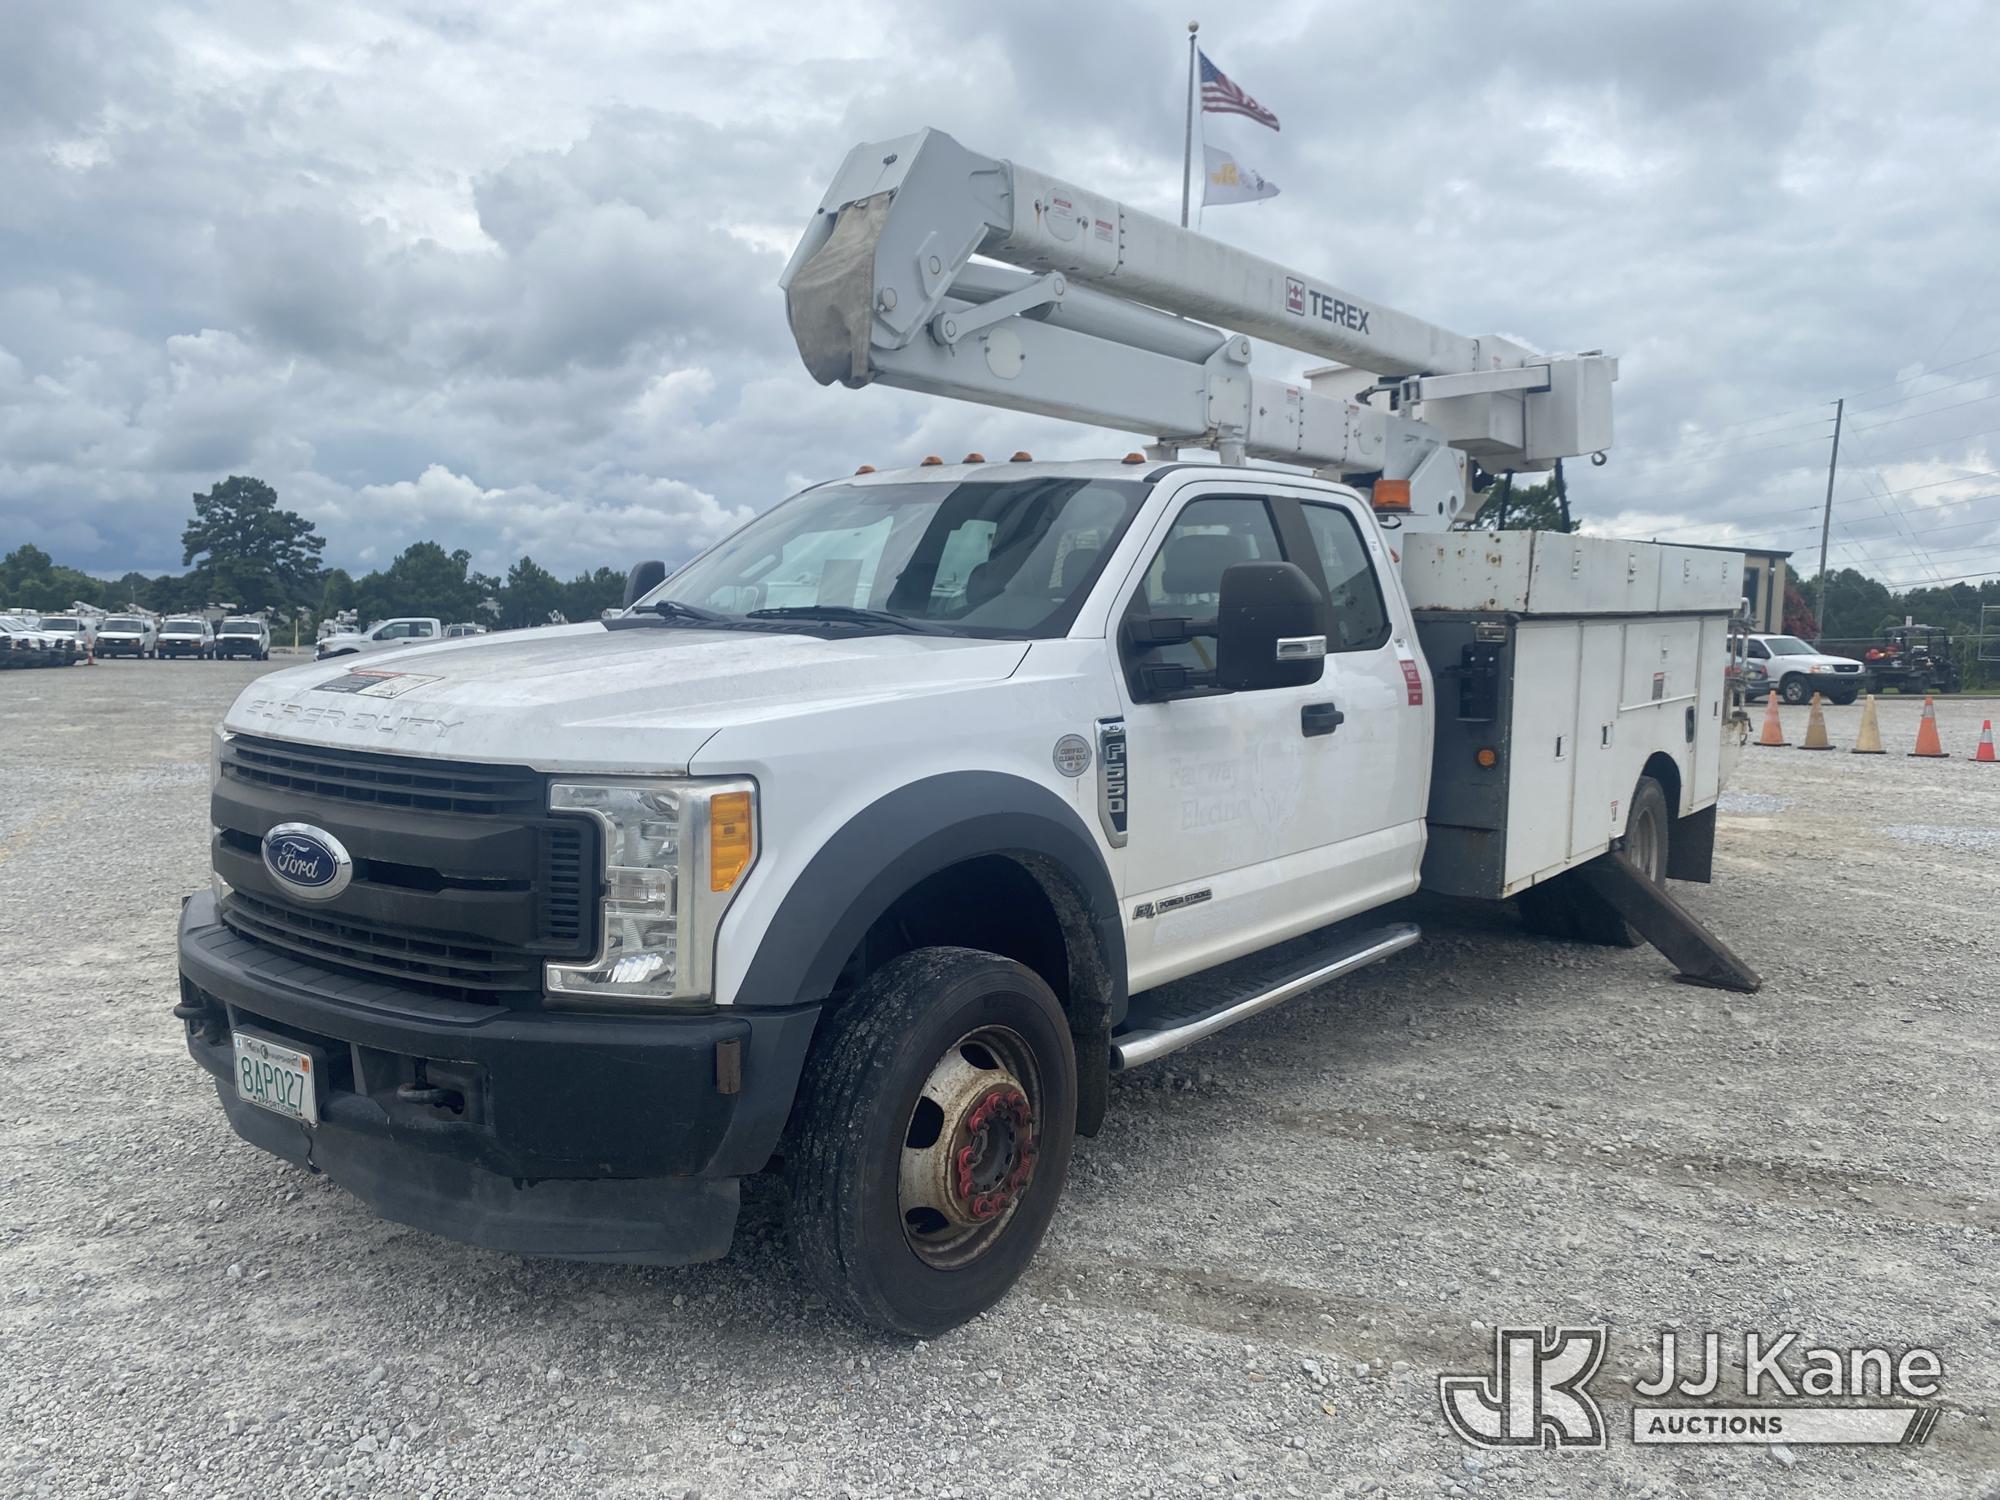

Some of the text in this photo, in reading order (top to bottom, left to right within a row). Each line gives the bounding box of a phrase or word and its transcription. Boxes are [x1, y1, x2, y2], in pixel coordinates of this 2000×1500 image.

[1308, 289, 1371, 336] TEREX
[246, 699, 465, 738] SUPER DUTY
[277, 842, 320, 879] Ford
[1159, 896, 1184, 909] POWER
[1184, 889, 1212, 902] STROKE
[241, 1056, 305, 1111] 8AP027
